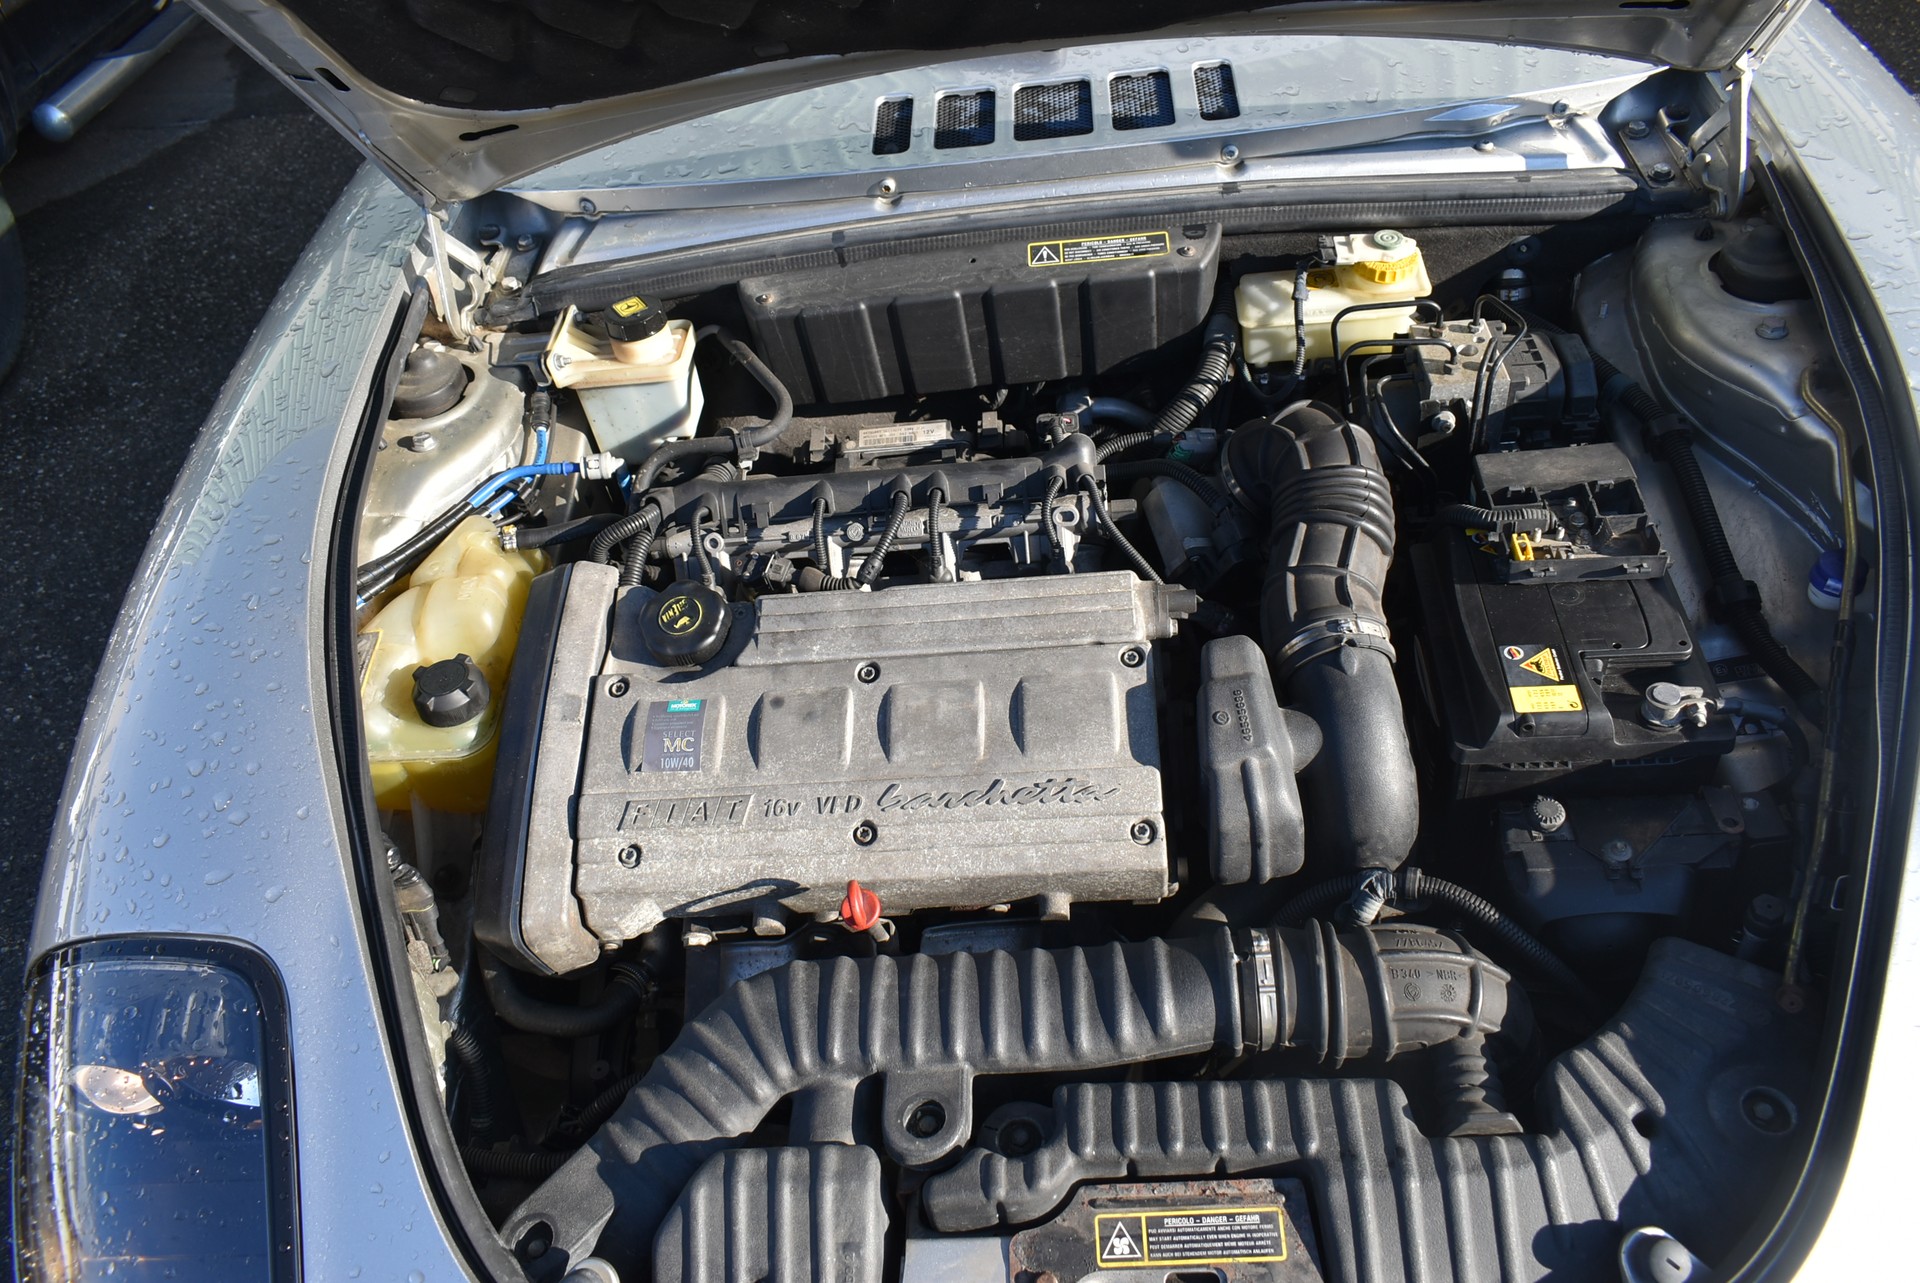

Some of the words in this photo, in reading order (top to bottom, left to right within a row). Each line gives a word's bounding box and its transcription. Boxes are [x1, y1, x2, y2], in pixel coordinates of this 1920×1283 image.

[663, 730, 696, 738] SELECT
[662, 737, 695, 753] MC
[660, 756, 694, 770] 10W/40
[632, 800, 743, 825] FIAT
[1164, 1217, 1194, 1226] PERICOLO
[1202, 1216, 1227, 1224] DANGER
[1235, 1214, 1260, 1223] GEFAHR
